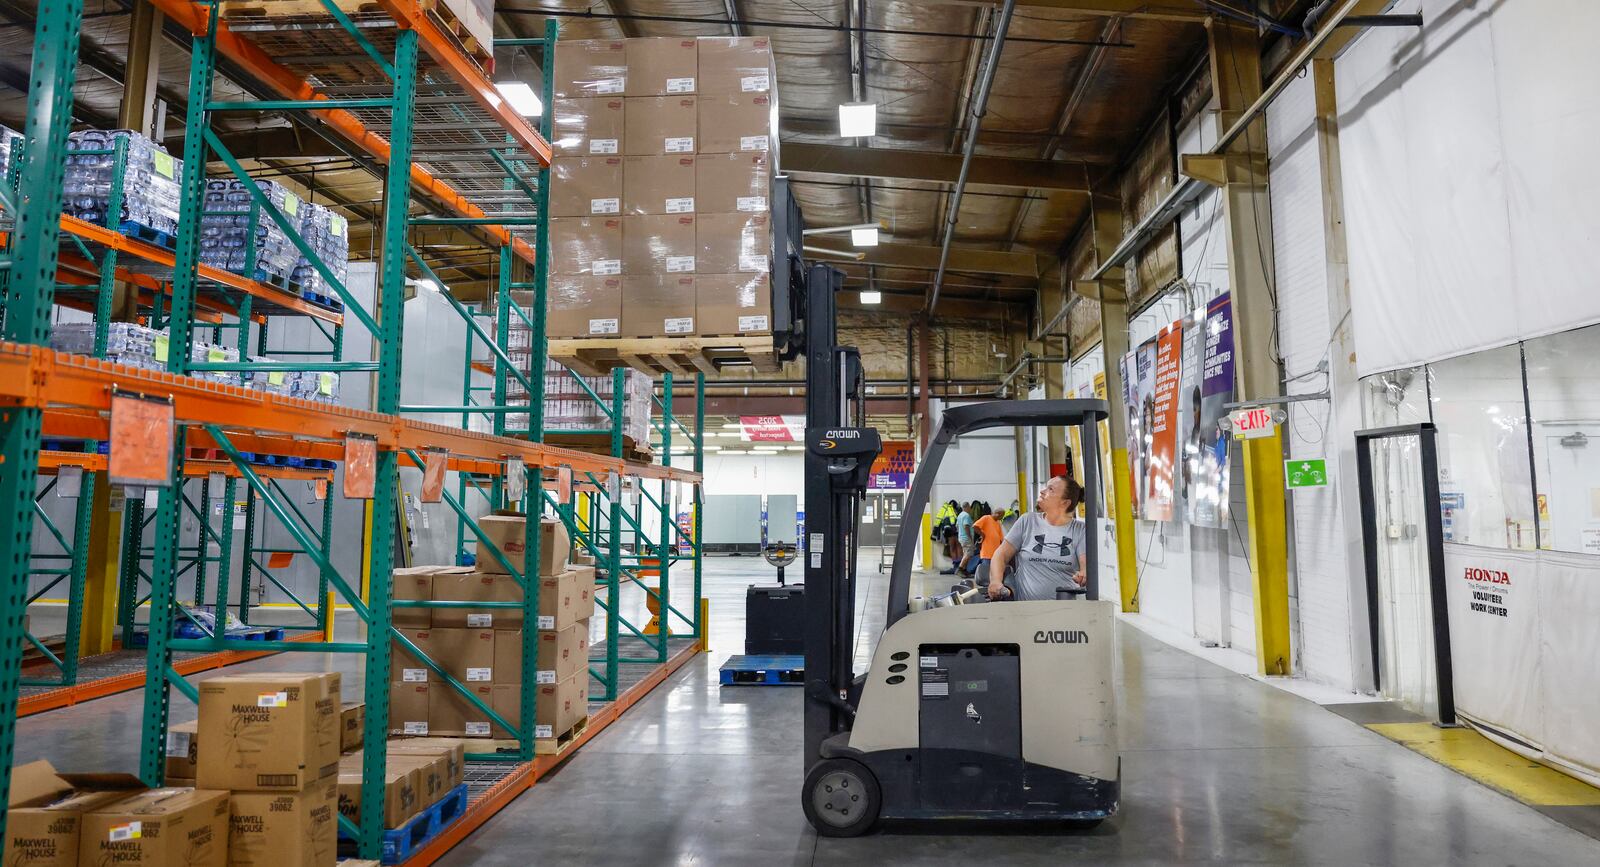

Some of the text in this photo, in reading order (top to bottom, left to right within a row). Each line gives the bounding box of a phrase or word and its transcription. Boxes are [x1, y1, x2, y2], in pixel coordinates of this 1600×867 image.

[1204, 351, 1231, 370] COMMUNITIES
[1241, 409, 1265, 430] EXIT
[826, 430, 860, 439] CROWN
[1048, 558, 1072, 566] ARMOUR
[1464, 567, 1511, 585] HONDA
[1471, 602, 1508, 617] WORK CENTER
[1034, 630, 1088, 644] CROWN
[232, 704, 270, 714] MAXWELL
[243, 714, 270, 724] HOUSE
[237, 825, 264, 834] HOUSE
[14, 838, 56, 848] MAXWELL
[100, 840, 142, 851] MAXWELL
[26, 847, 56, 859] HOUSE
[112, 851, 142, 862] HOUSE
